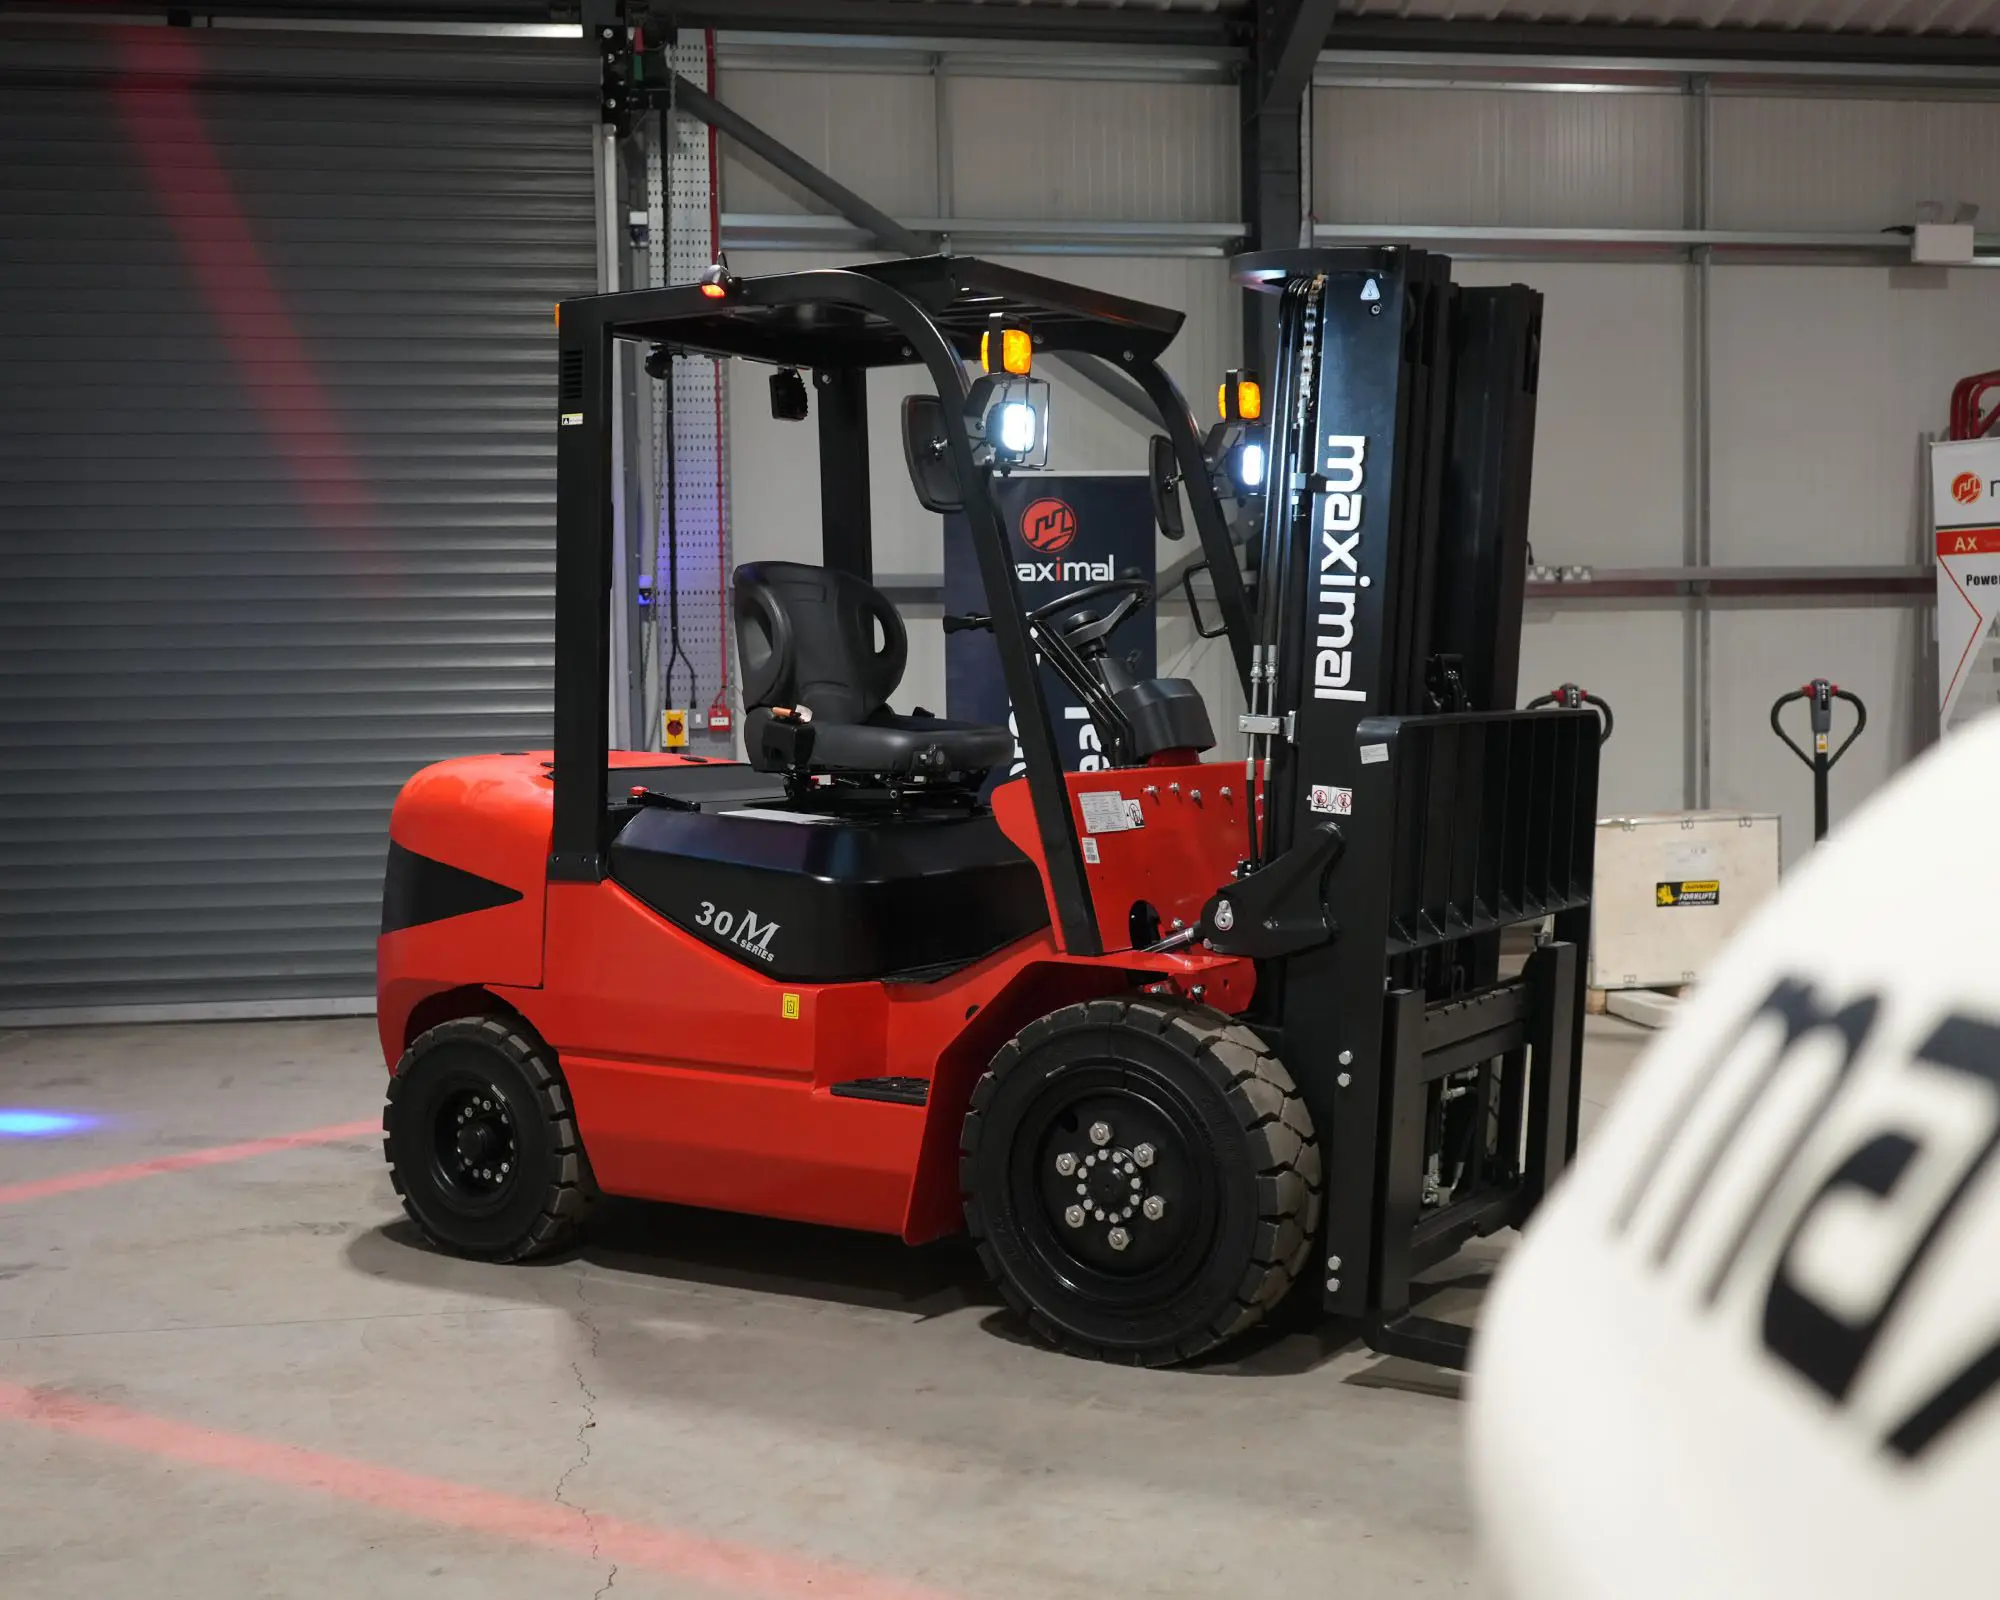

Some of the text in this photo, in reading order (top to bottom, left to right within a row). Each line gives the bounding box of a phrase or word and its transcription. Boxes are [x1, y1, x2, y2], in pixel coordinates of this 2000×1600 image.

[1954, 536, 1978, 551] AX
[1014, 554, 1114, 582] aximal
[1314, 435, 1371, 702] maximal
[1966, 574, 2000, 586] Powe
[1680, 892, 1716, 901] FORKLIFTS
[740, 939, 775, 962] SERIES
